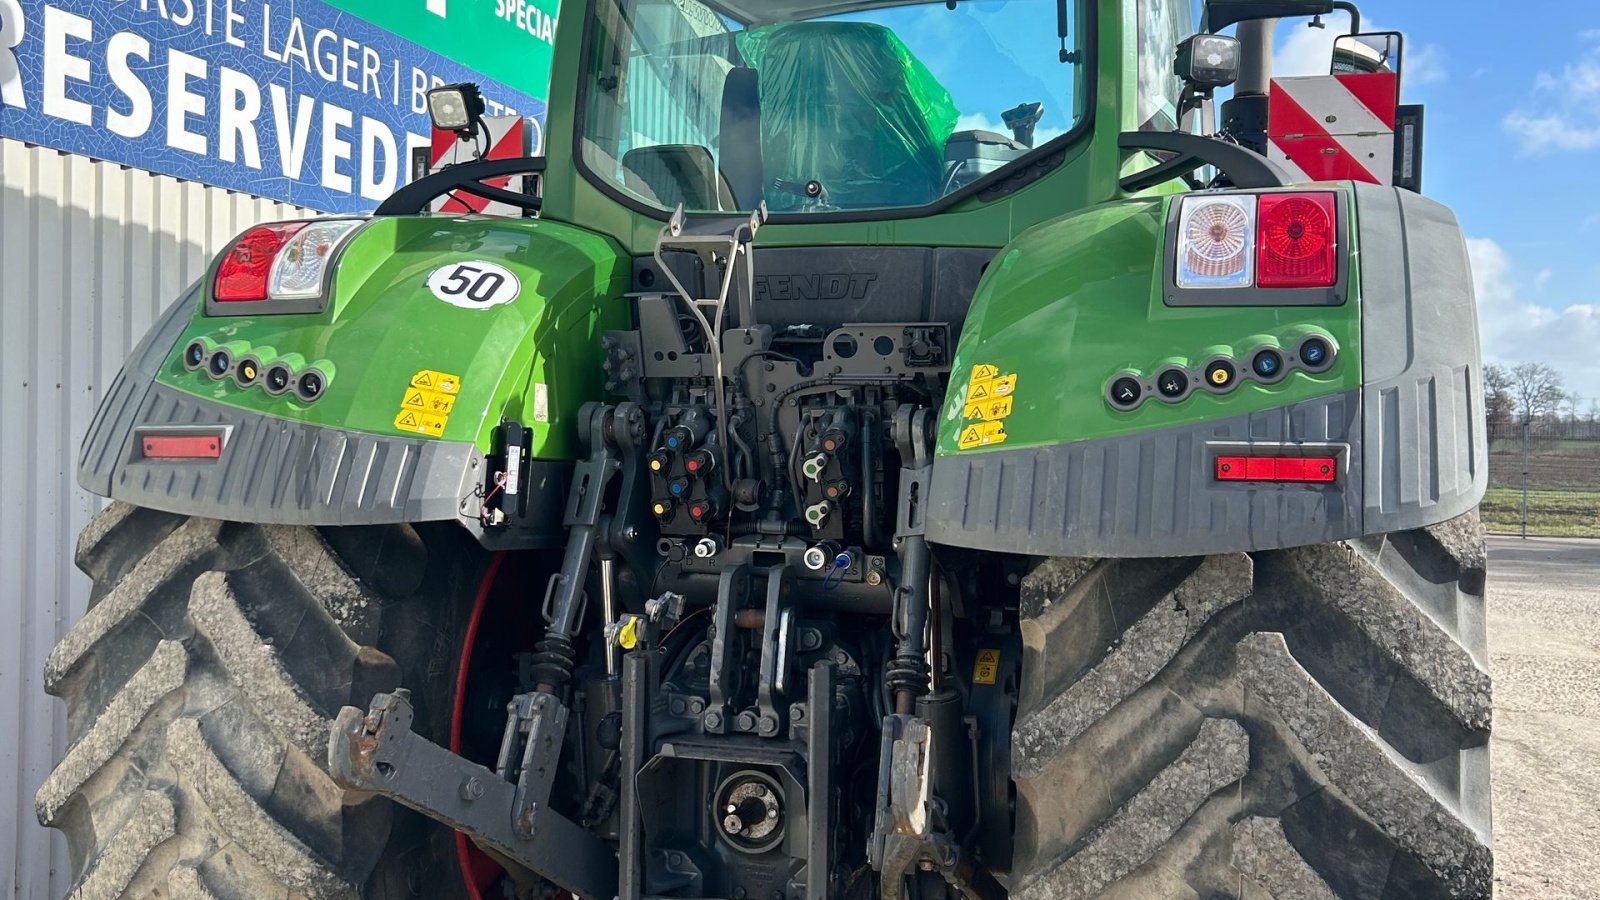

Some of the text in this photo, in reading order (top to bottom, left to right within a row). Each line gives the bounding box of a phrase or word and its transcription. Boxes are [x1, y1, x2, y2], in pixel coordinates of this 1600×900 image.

[495, 0, 556, 46] SPECIA
[264, 4, 381, 99] LAGER
[440, 265, 505, 302] 50
[754, 273, 878, 301] FENDT
